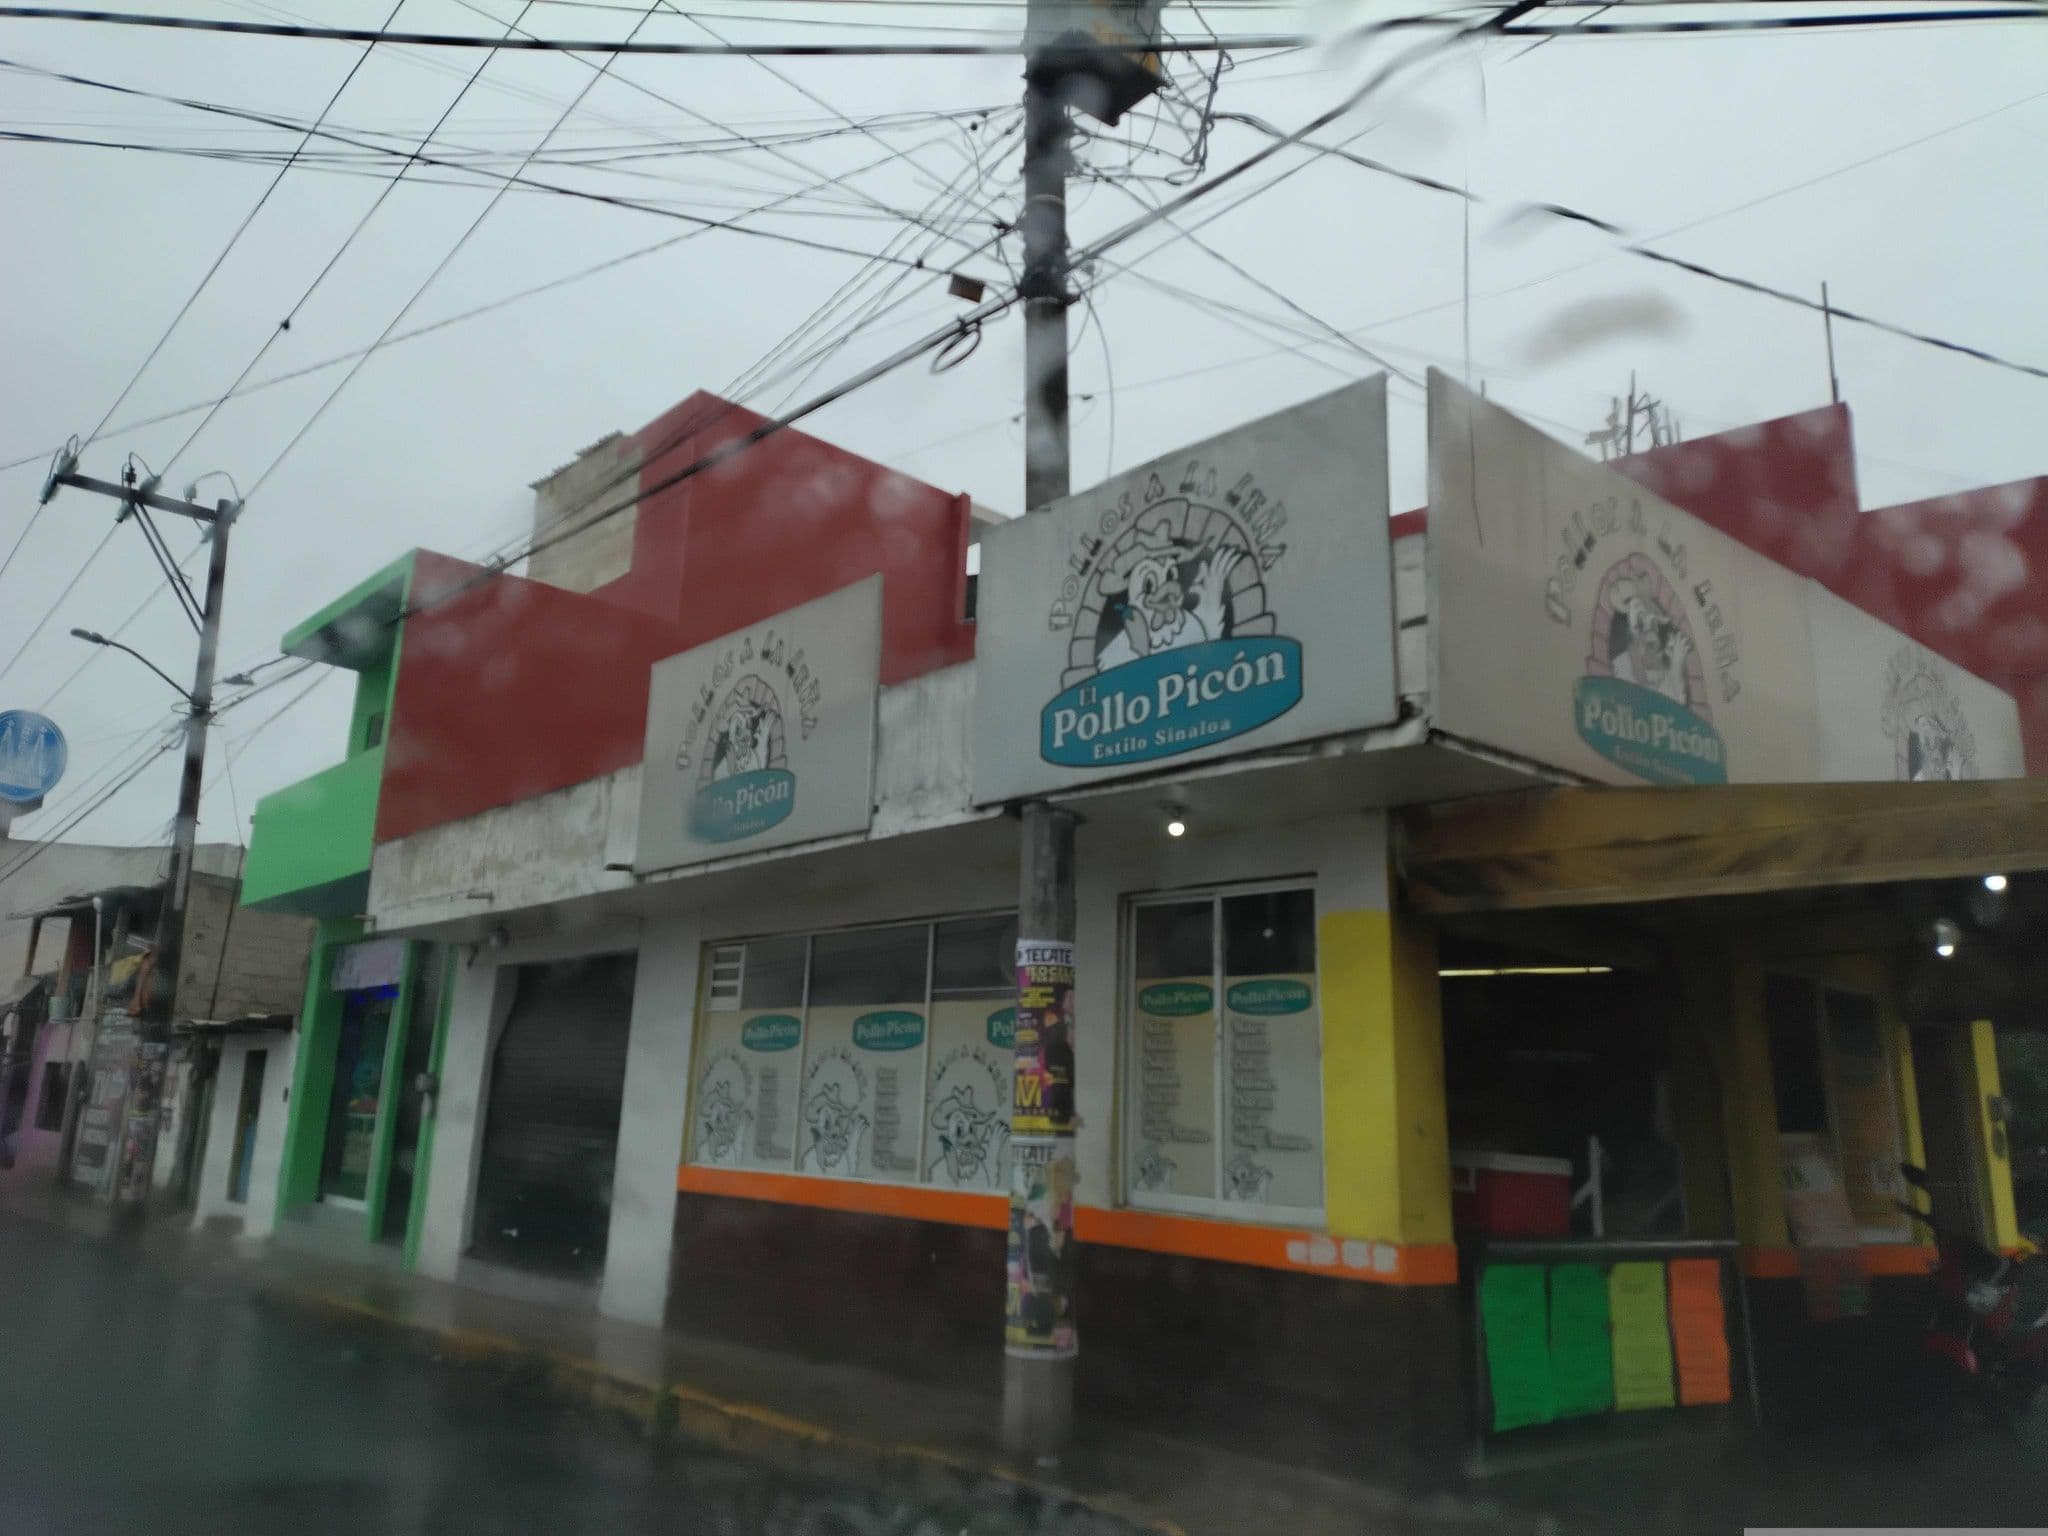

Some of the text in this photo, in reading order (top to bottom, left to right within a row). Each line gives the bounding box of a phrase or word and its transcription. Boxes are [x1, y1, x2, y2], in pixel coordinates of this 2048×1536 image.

[1049, 492, 1132, 632] POLLOS
[1144, 472, 1165, 504] A
[1180, 460, 1218, 498] LA
[1053, 650, 1285, 748] Pollo Picón
[1093, 718, 1231, 760] Estilo Sinaloa
[1583, 700, 1649, 744] Pollo
[735, 778, 789, 815] Picón
[1026, 948, 1072, 964] TECATE
